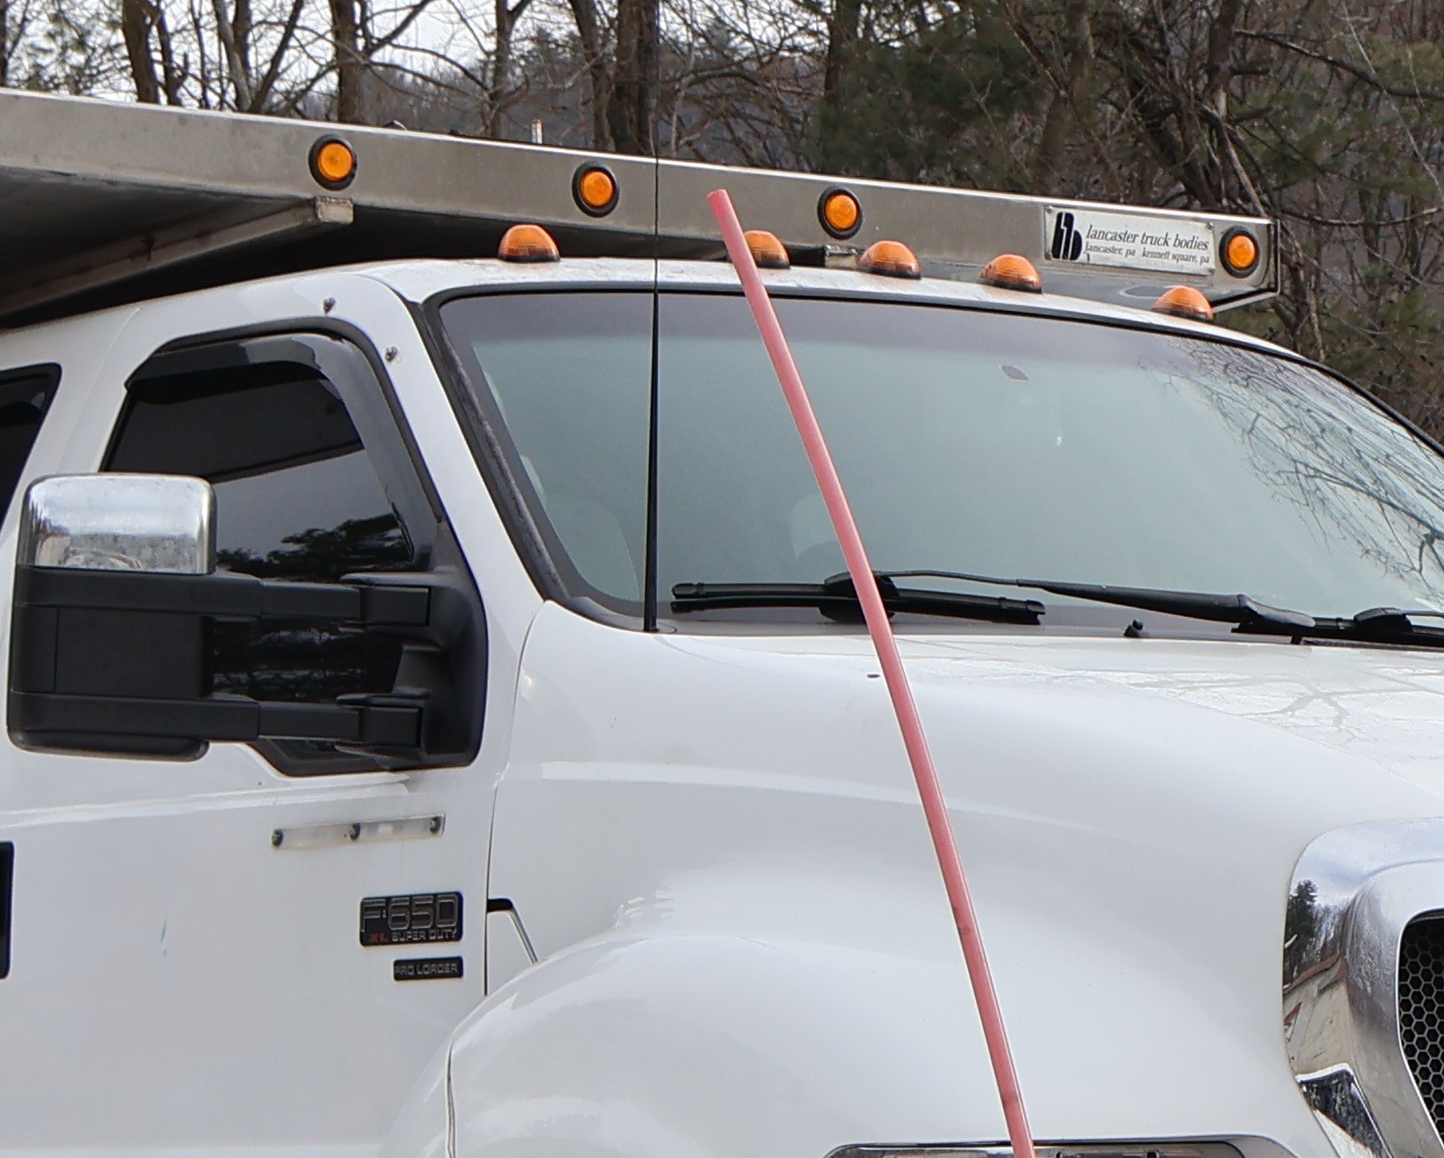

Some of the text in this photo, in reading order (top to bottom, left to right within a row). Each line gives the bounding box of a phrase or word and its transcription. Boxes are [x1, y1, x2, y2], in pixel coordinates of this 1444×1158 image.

[1086, 224, 1210, 251] lancaster truck bodies
[391, 930, 426, 943] SUPER
[428, 928, 458, 940] DUTY
[394, 963, 459, 976] PRO LOADER
